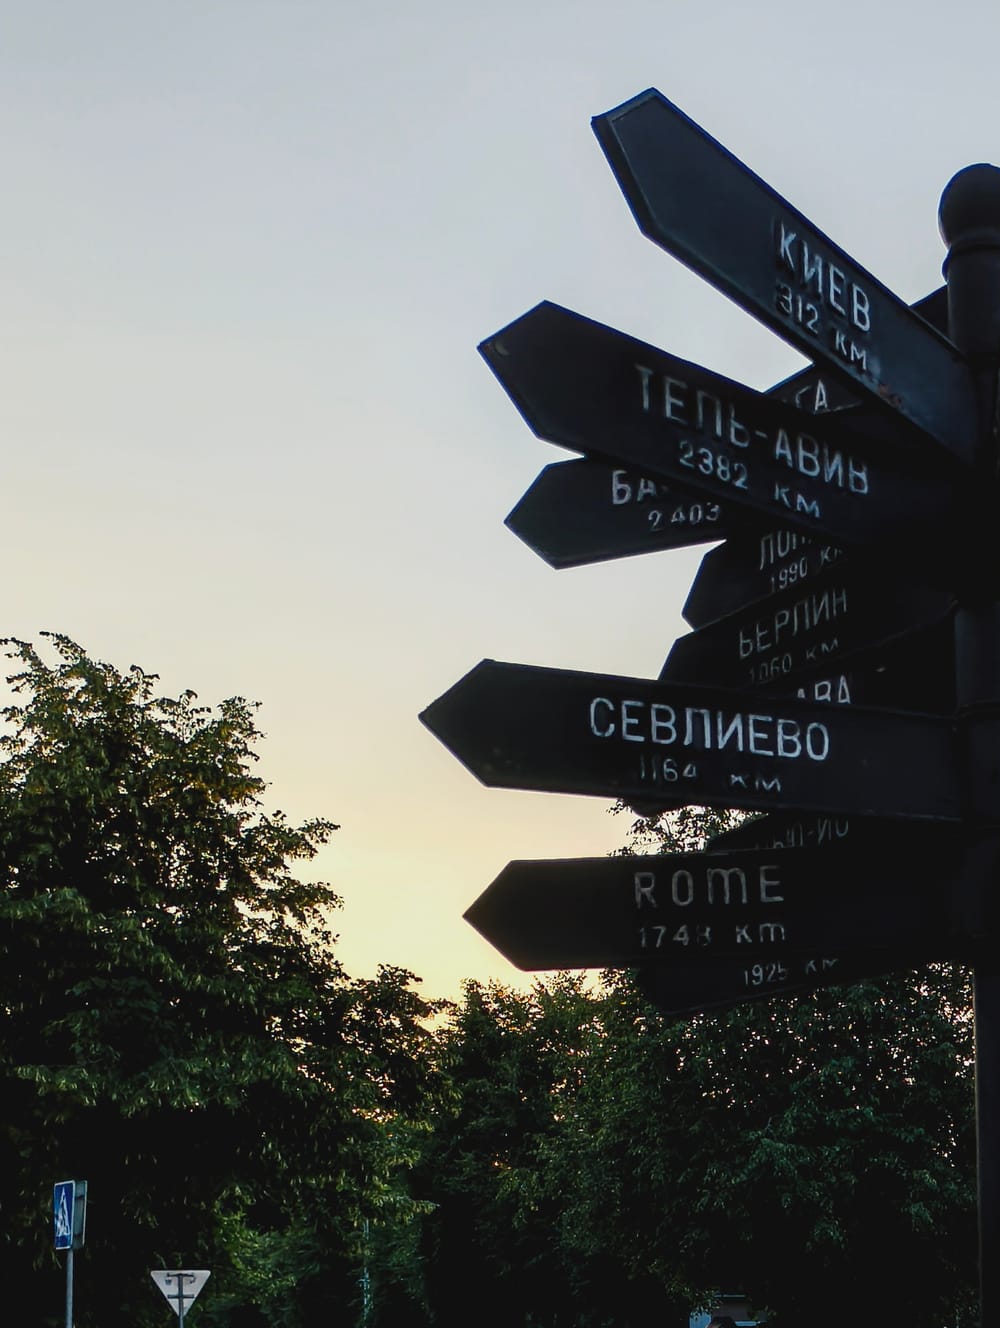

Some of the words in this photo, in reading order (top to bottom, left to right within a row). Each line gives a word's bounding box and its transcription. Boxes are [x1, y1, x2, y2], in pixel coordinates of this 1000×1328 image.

[781, 220, 870, 332] КИЕВ
[775, 280, 818, 335] 312
[611, 469, 670, 506] БА
[678, 440, 749, 491] 2382
[647, 501, 722, 532] 2403
[770, 556, 808, 594] 1990
[589, 696, 831, 762] СЕВЛИЕВО
[639, 753, 698, 783] 1164
[633, 864, 785, 909] ROME
